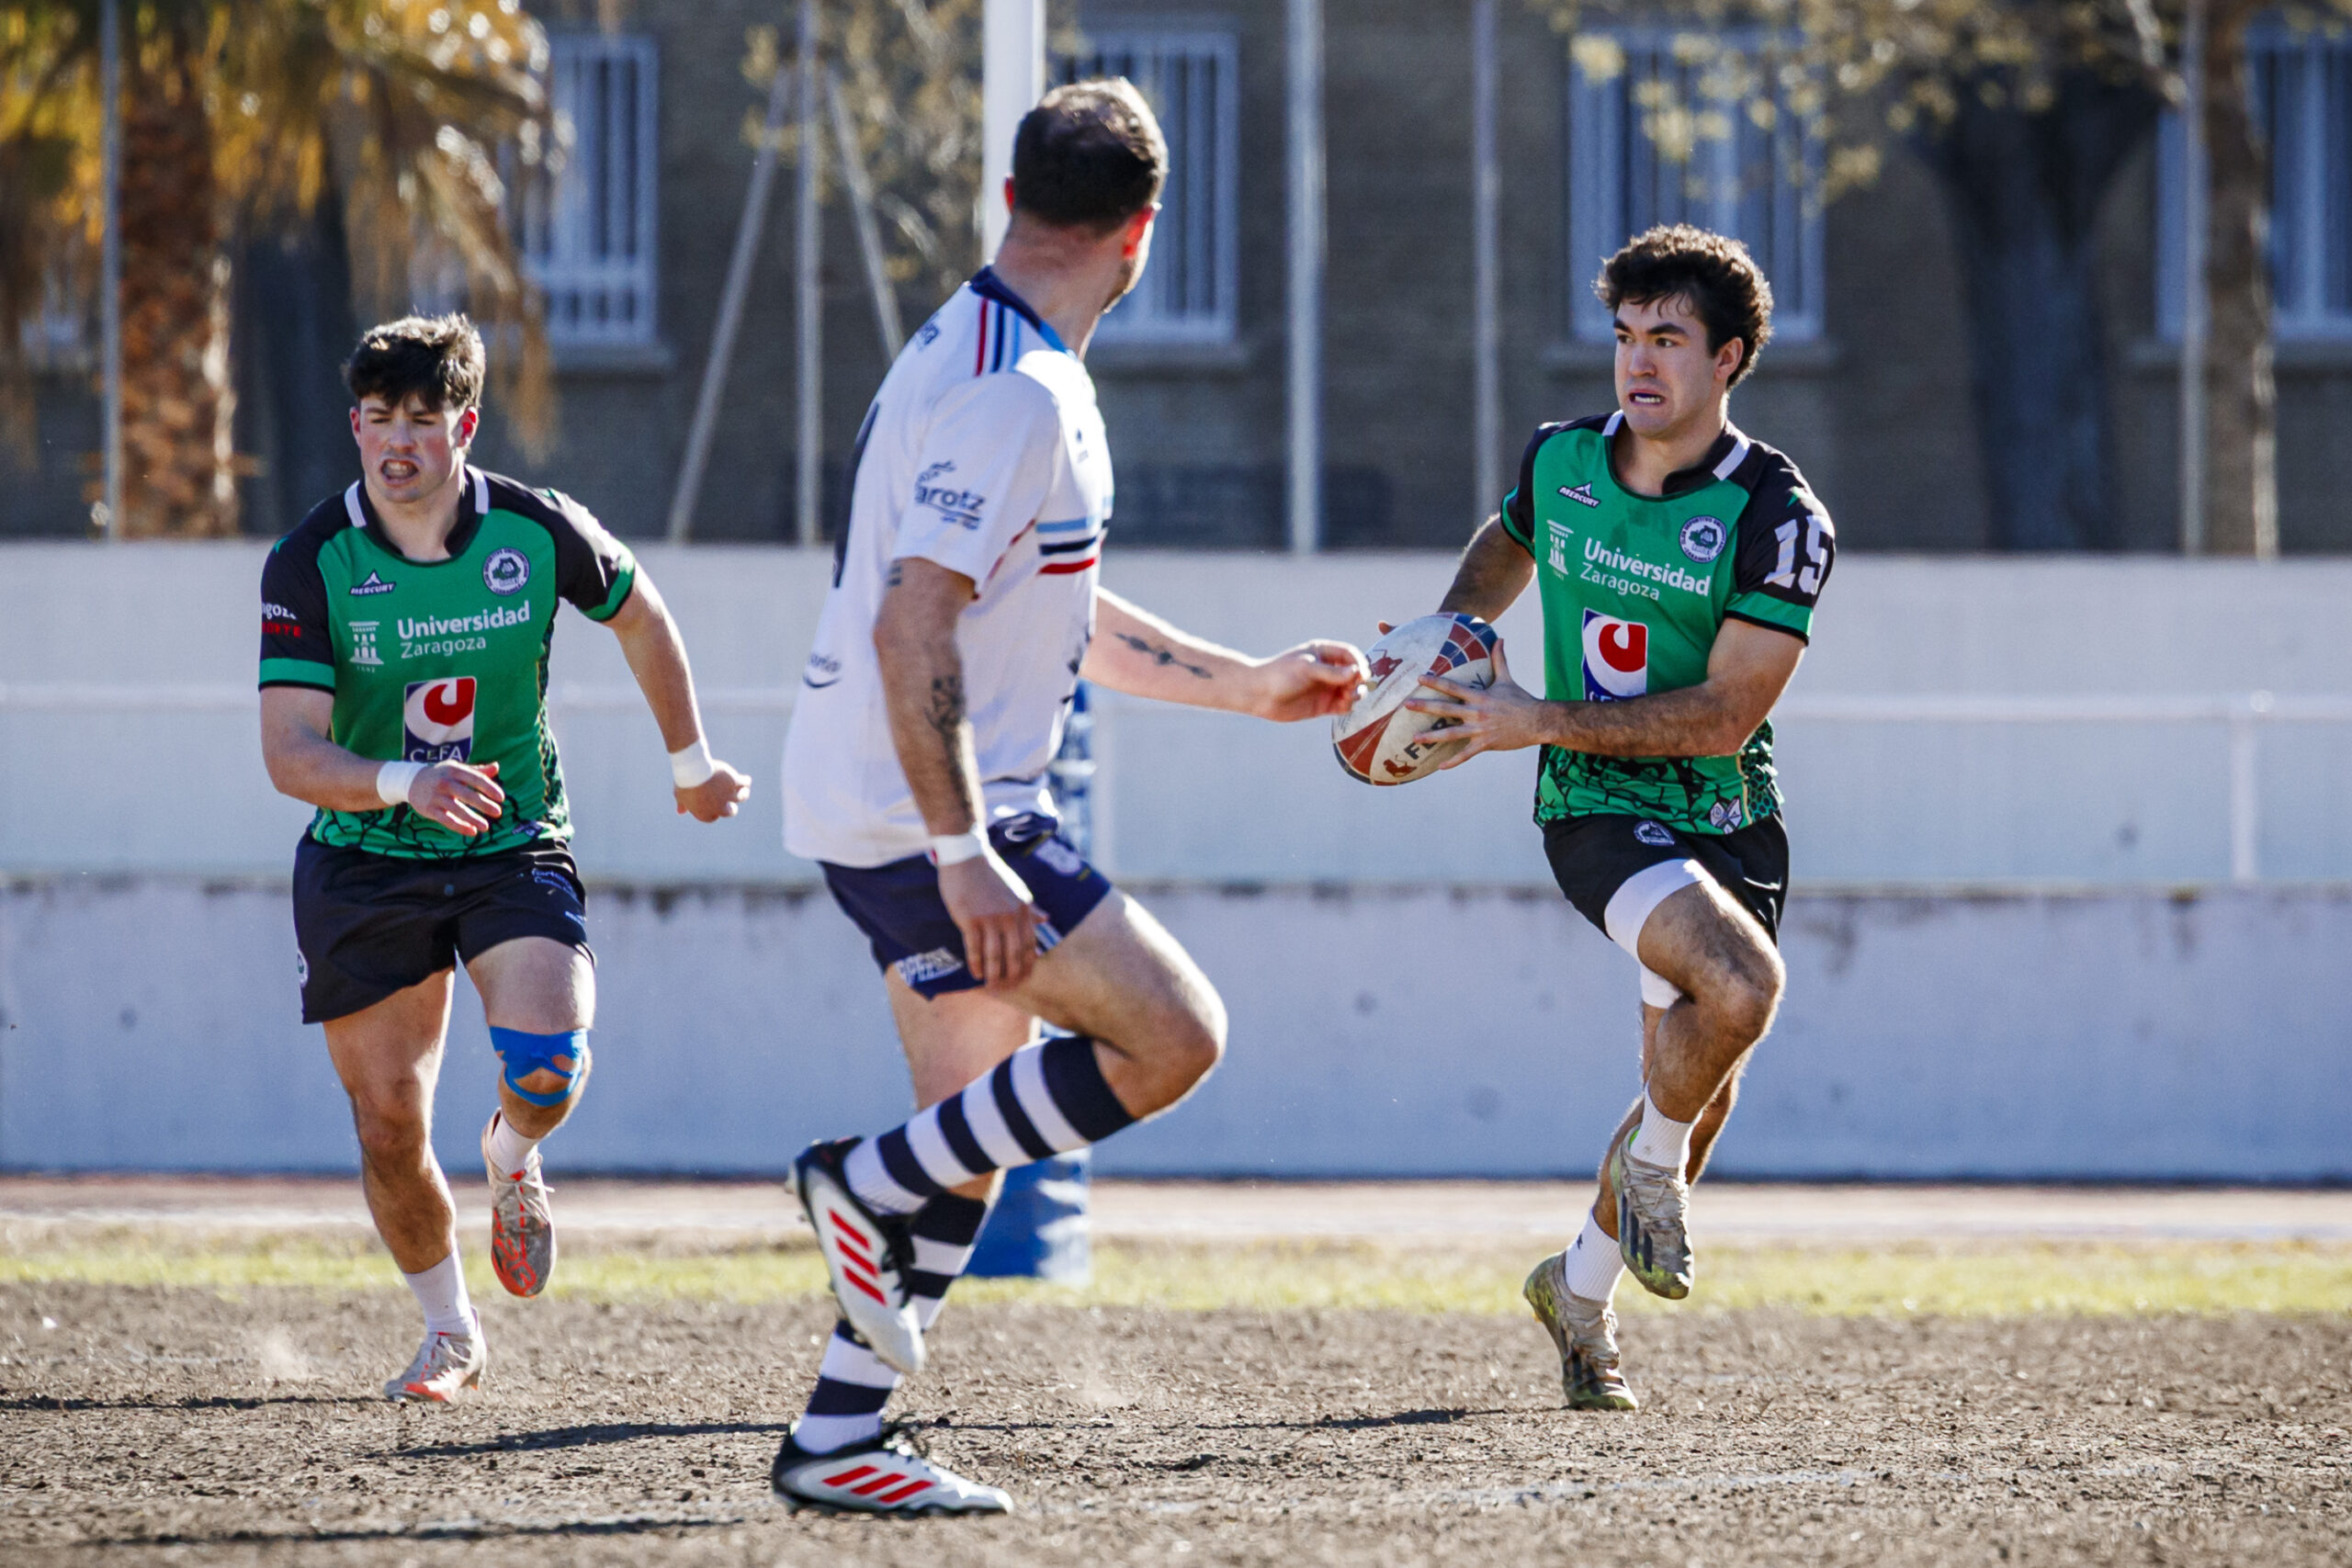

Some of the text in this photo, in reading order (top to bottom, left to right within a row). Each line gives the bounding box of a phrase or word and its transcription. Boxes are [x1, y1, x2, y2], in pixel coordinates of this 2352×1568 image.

[1558, 486, 1600, 507] MERCURY
[1584, 536, 1712, 597] Universidad
[1763, 514, 1835, 595] 15
[350, 582, 395, 595] MERCURY
[1579, 561, 1660, 601] Zaragoza
[397, 599, 530, 640] Universidad
[400, 636, 487, 660] Zaragoza
